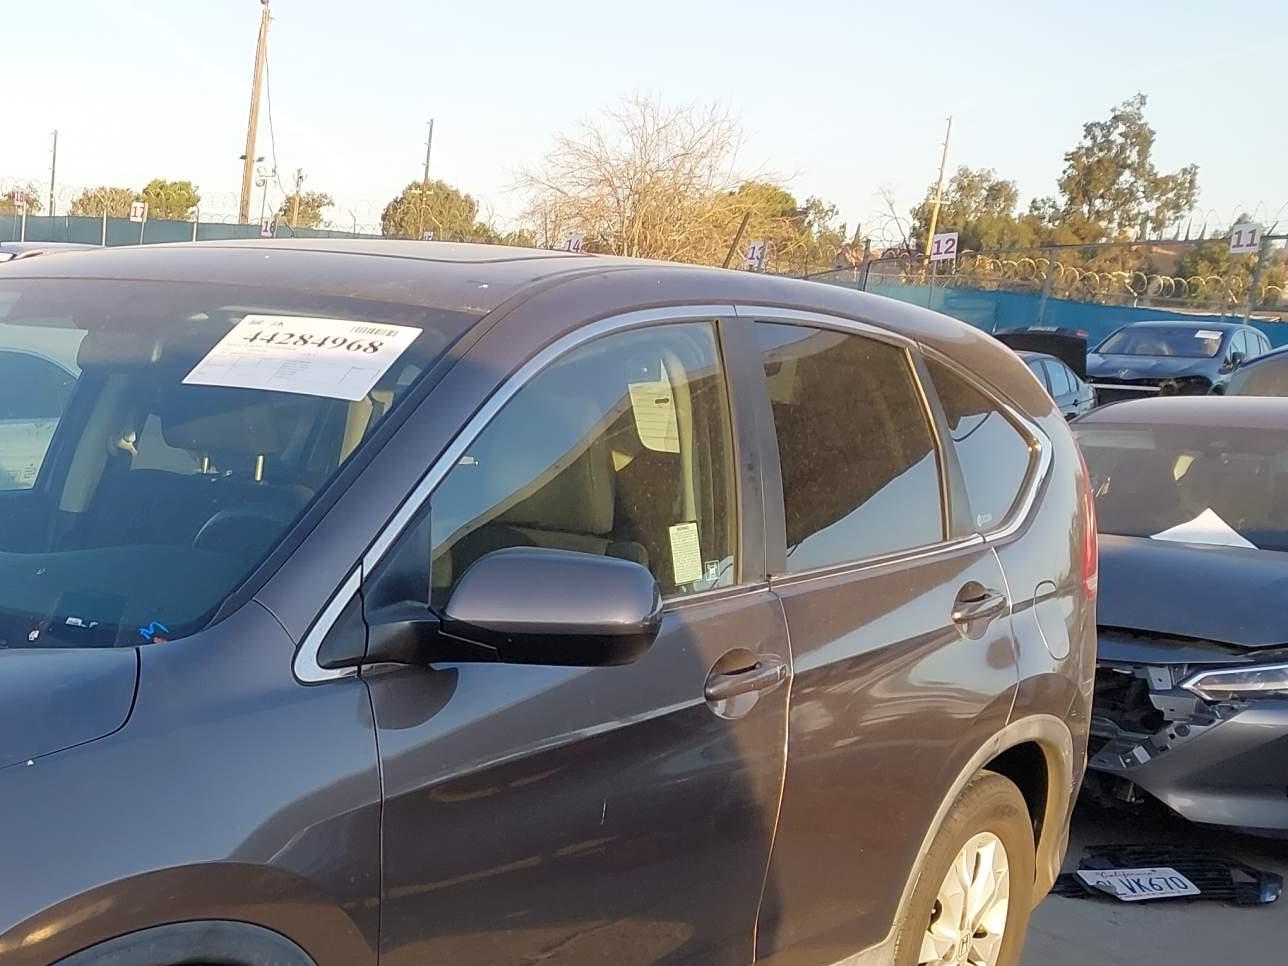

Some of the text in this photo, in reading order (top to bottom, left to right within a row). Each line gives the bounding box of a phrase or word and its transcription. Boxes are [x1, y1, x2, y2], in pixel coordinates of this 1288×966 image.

[932, 238, 956, 255] 12
[1232, 228, 1258, 248] 11
[242, 330, 384, 354] 44284968
